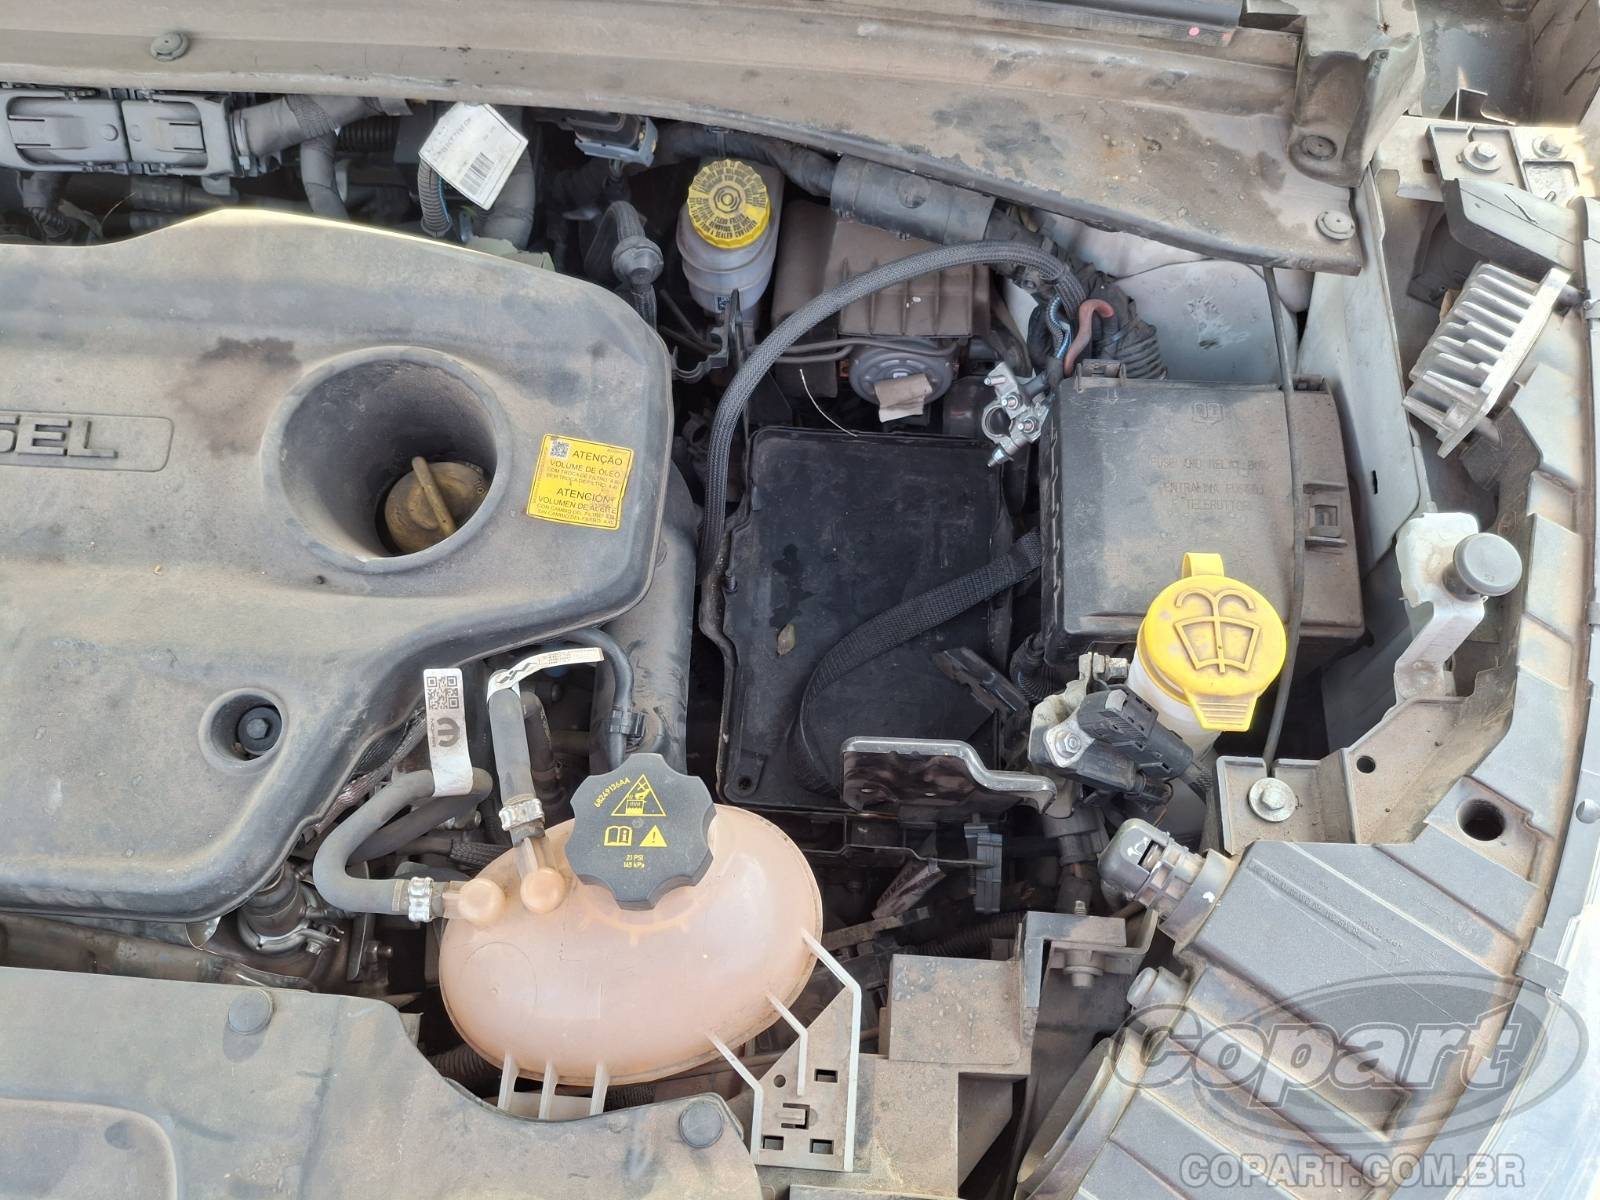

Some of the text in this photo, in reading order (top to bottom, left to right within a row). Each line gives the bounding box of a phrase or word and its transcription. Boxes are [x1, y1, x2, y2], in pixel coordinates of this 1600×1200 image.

[572, 449, 623, 466] ATENÇÃO
[550, 459, 583, 472] VOLUME
[585, 465, 598, 473] DE
[538, 496, 577, 509] VOLUMEN
[556, 487, 611, 505] ATENCIÓN
[633, 854, 645, 862] PSI
